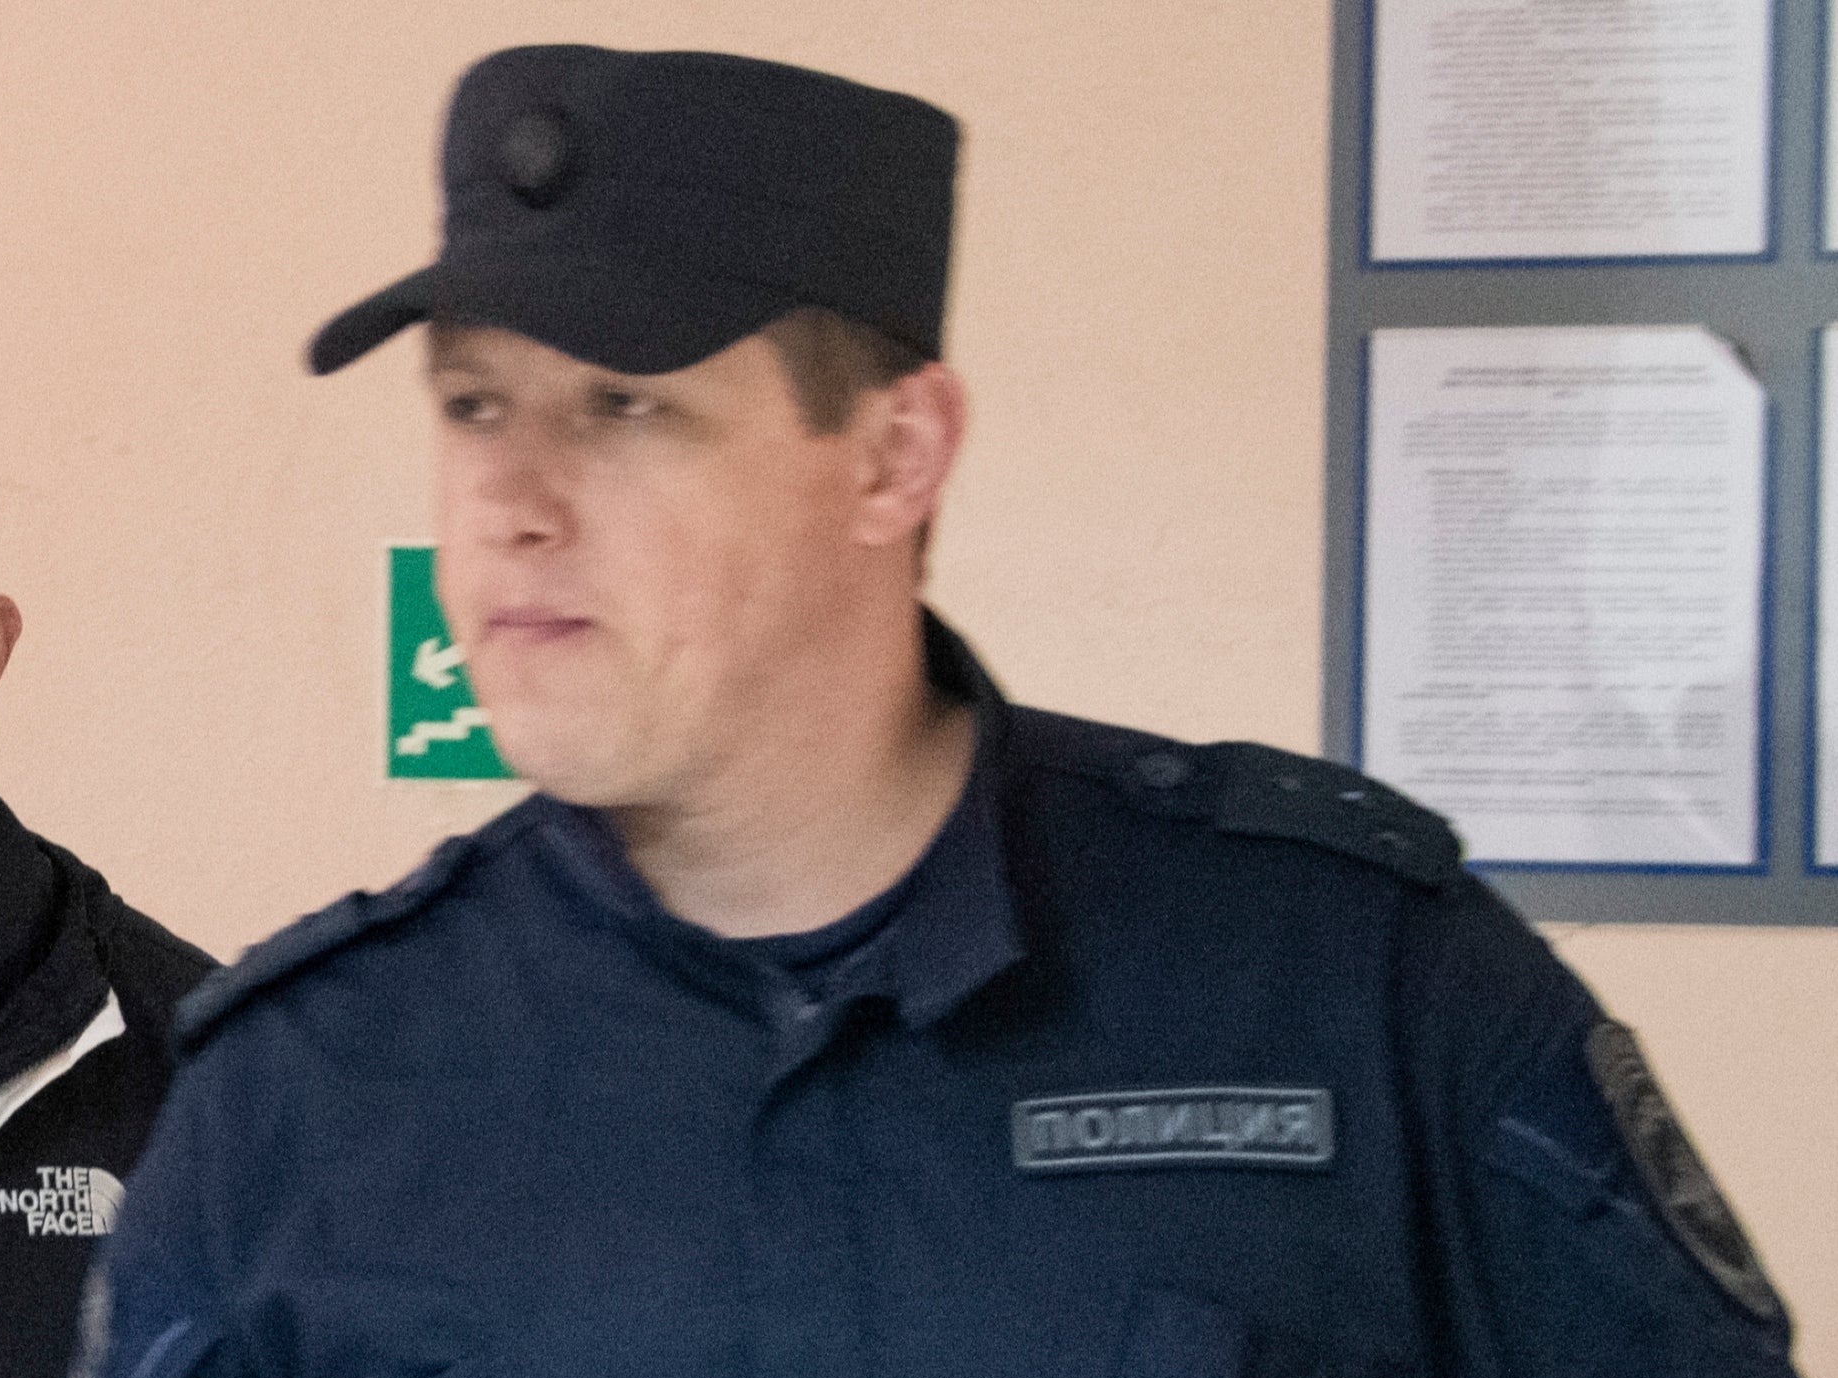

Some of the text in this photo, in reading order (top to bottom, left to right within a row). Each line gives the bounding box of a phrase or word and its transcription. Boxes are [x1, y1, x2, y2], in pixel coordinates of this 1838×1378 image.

[1031, 1104, 1314, 1150] ПОЛИЦИЯ
[36, 1166, 89, 1189] THE
[26, 1210, 93, 1236] FACE
